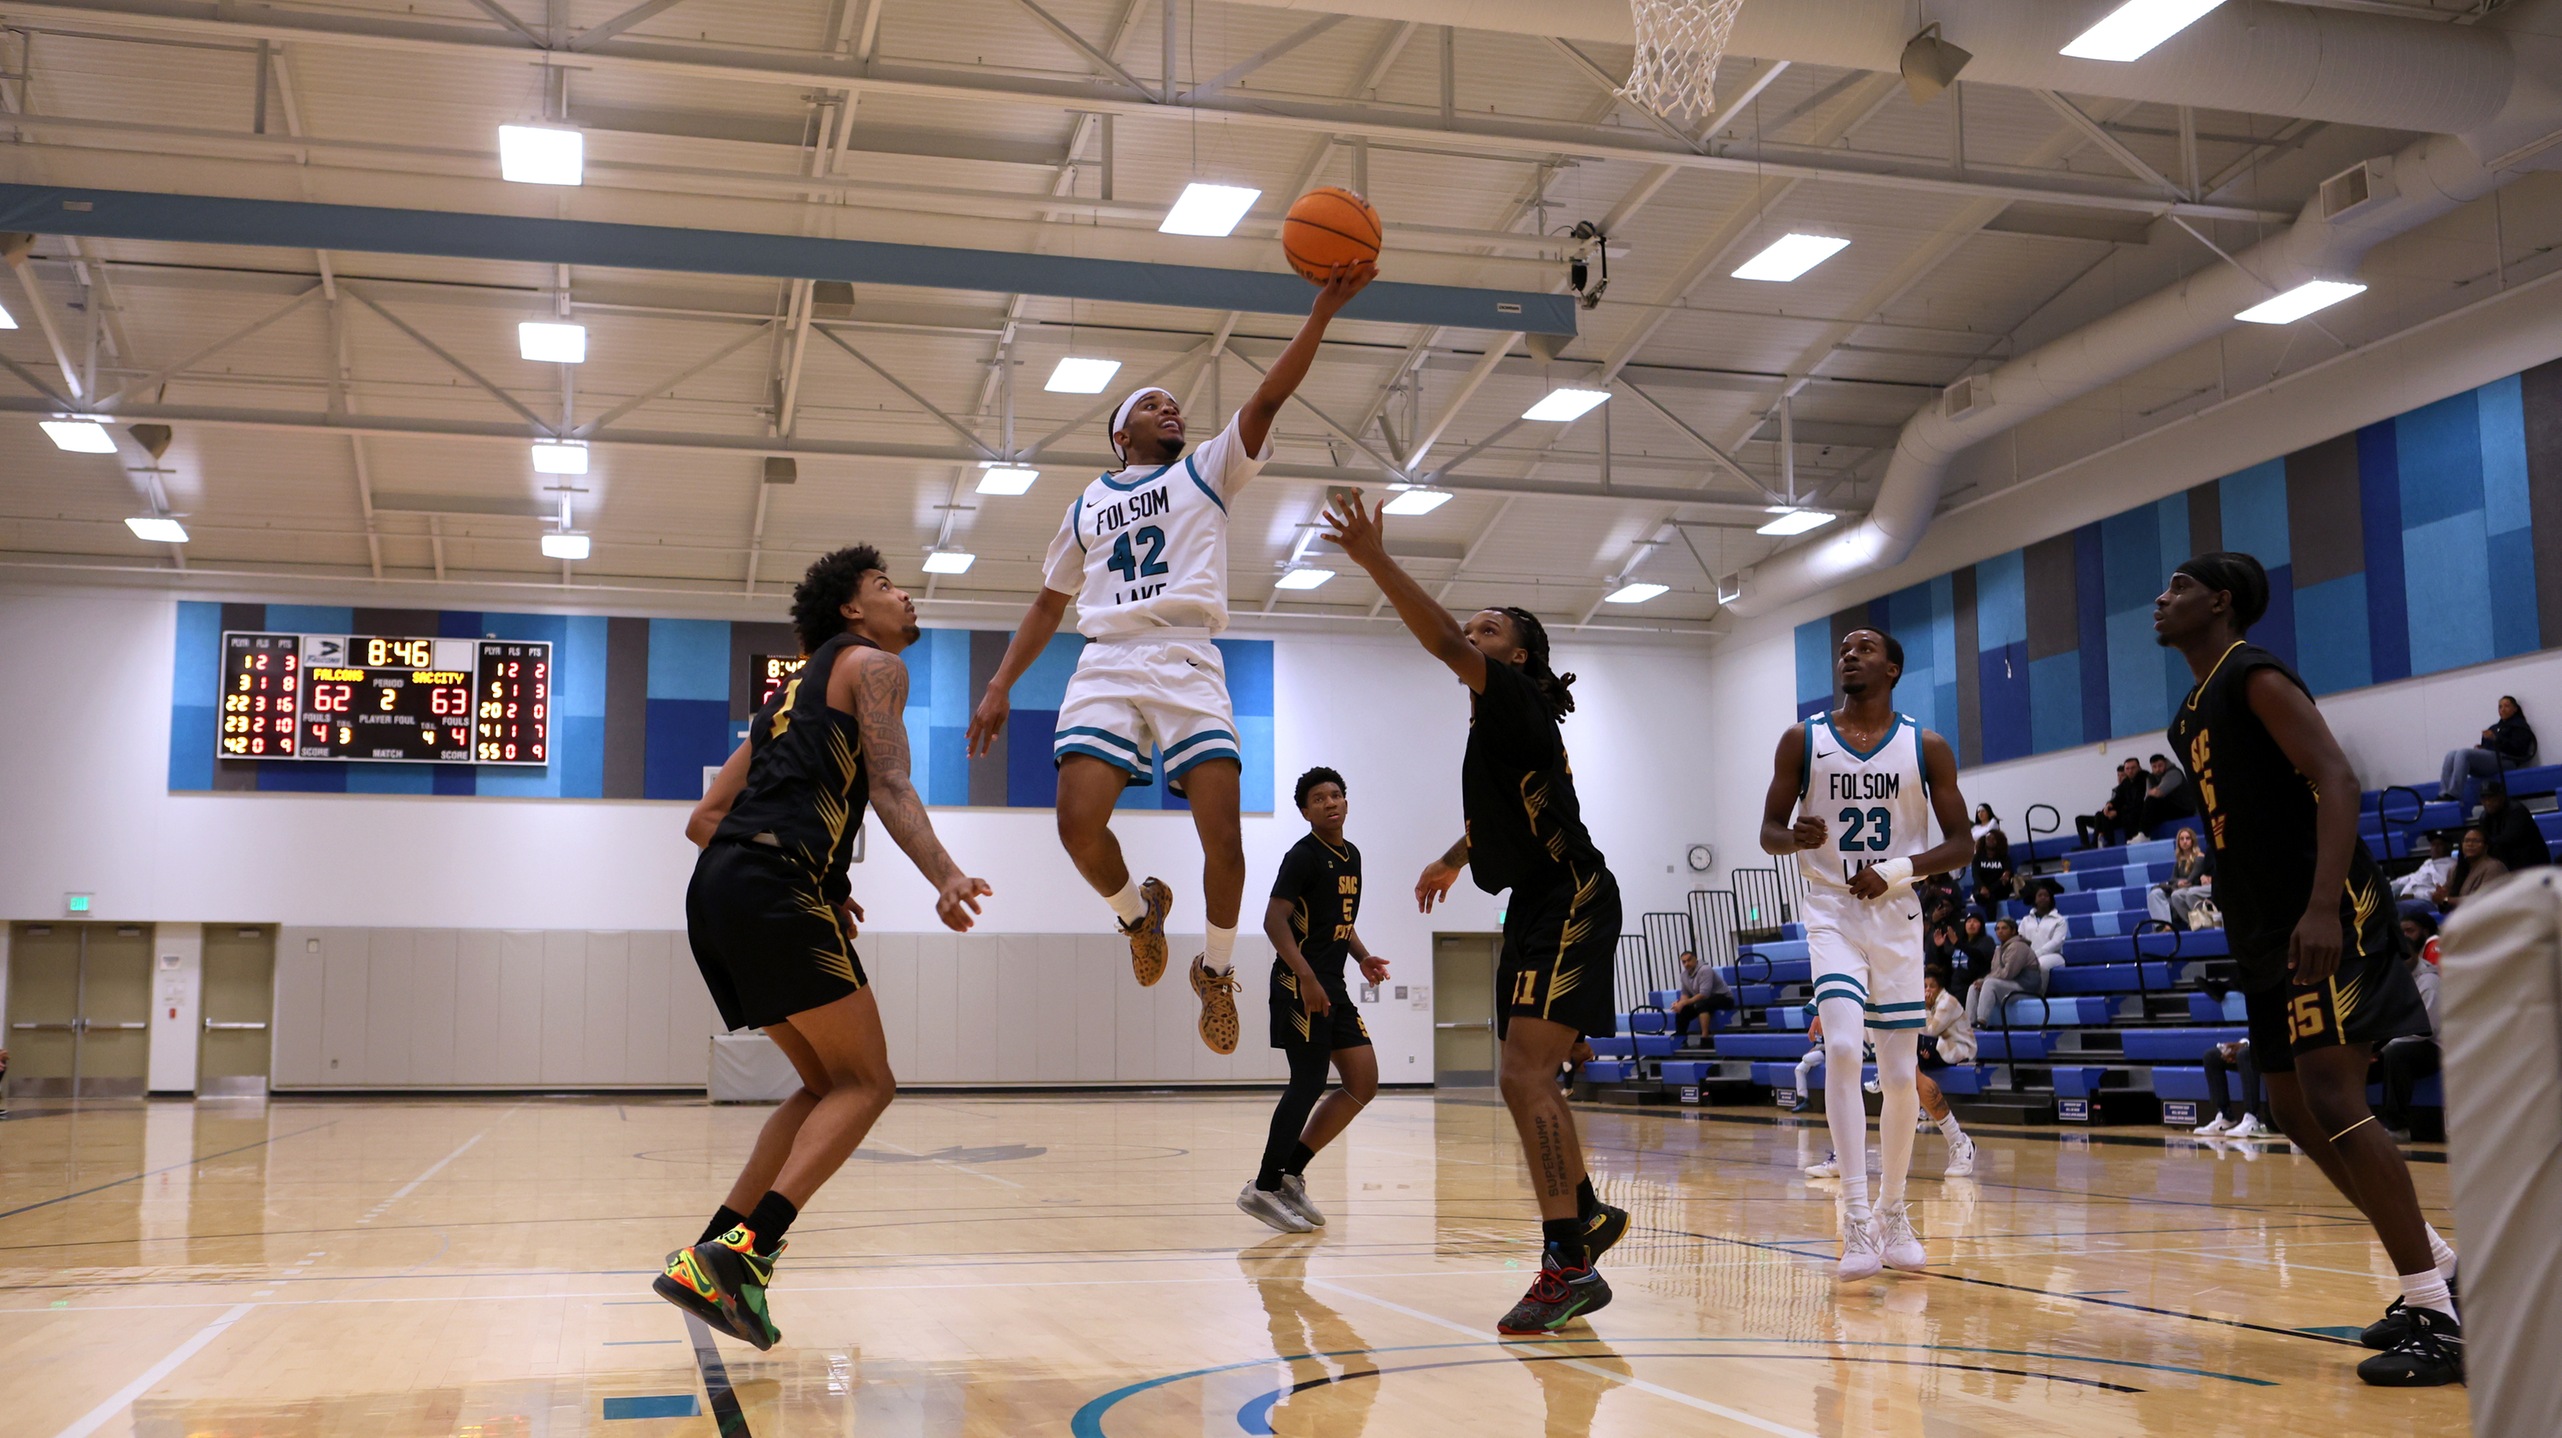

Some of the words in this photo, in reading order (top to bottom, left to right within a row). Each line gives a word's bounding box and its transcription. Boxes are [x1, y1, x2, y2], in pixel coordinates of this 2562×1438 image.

[1097, 486, 1169, 535] FOLSOM
[1107, 525, 1169, 582] 42
[367, 639, 429, 668] 8:46
[484, 646, 501, 656] PLYR
[508, 647, 521, 656] FLS
[529, 648, 541, 657] PTS
[245, 655, 252, 669] 1
[256, 654, 268, 670] 2
[285, 655, 296, 671] 3
[497, 663, 504, 677] 1
[508, 662, 519, 678] 2
[535, 663, 545, 679] 2
[239, 674, 251, 691] 3
[260, 676, 267, 690] 1
[283, 676, 295, 692] 8
[313, 668, 365, 682] FALCONS
[373, 678, 404, 688] PERIOD
[314, 684, 351, 711] 62
[491, 681, 503, 698] 5
[513, 684, 519, 697] 1
[535, 683, 545, 699] 3
[225, 694, 250, 712] 22
[255, 695, 266, 712] 3
[277, 696, 294, 712] 16
[380, 688, 396, 711] 2
[432, 688, 467, 714] 63
[770, 677, 803, 739] 1
[302, 713, 331, 723] FOULS
[479, 701, 502, 719] 20
[507, 703, 517, 718] 2
[533, 704, 544, 719] 0
[224, 715, 249, 733] 23
[253, 717, 265, 732] 2
[276, 717, 293, 733] 10
[359, 714, 392, 724] PLAYER
[394, 715, 415, 725] FOUL
[442, 717, 470, 726] FOULS
[312, 724, 327, 743] 4
[339, 727, 351, 744] 3
[422, 731, 435, 745] 4
[451, 728, 466, 746] 4
[479, 723, 502, 738] 41
[511, 725, 517, 738] 1
[534, 724, 543, 738] 7
[223, 736, 248, 754] 42
[252, 737, 264, 753] 0
[280, 738, 292, 753] 9
[301, 747, 330, 757] SCORE
[372, 749, 403, 758] MATCH
[478, 742, 500, 760] 55
[505, 743, 516, 759] 0
[532, 744, 543, 759] 9
[441, 751, 468, 760] SCORE
[1830, 773, 1899, 800] FOLSOM
[1839, 807, 1891, 851] 23
[1338, 875, 1358, 895] SAC
[1342, 898, 1353, 922] 5
[1536, 1116, 1559, 1197] SUPERJUMP
